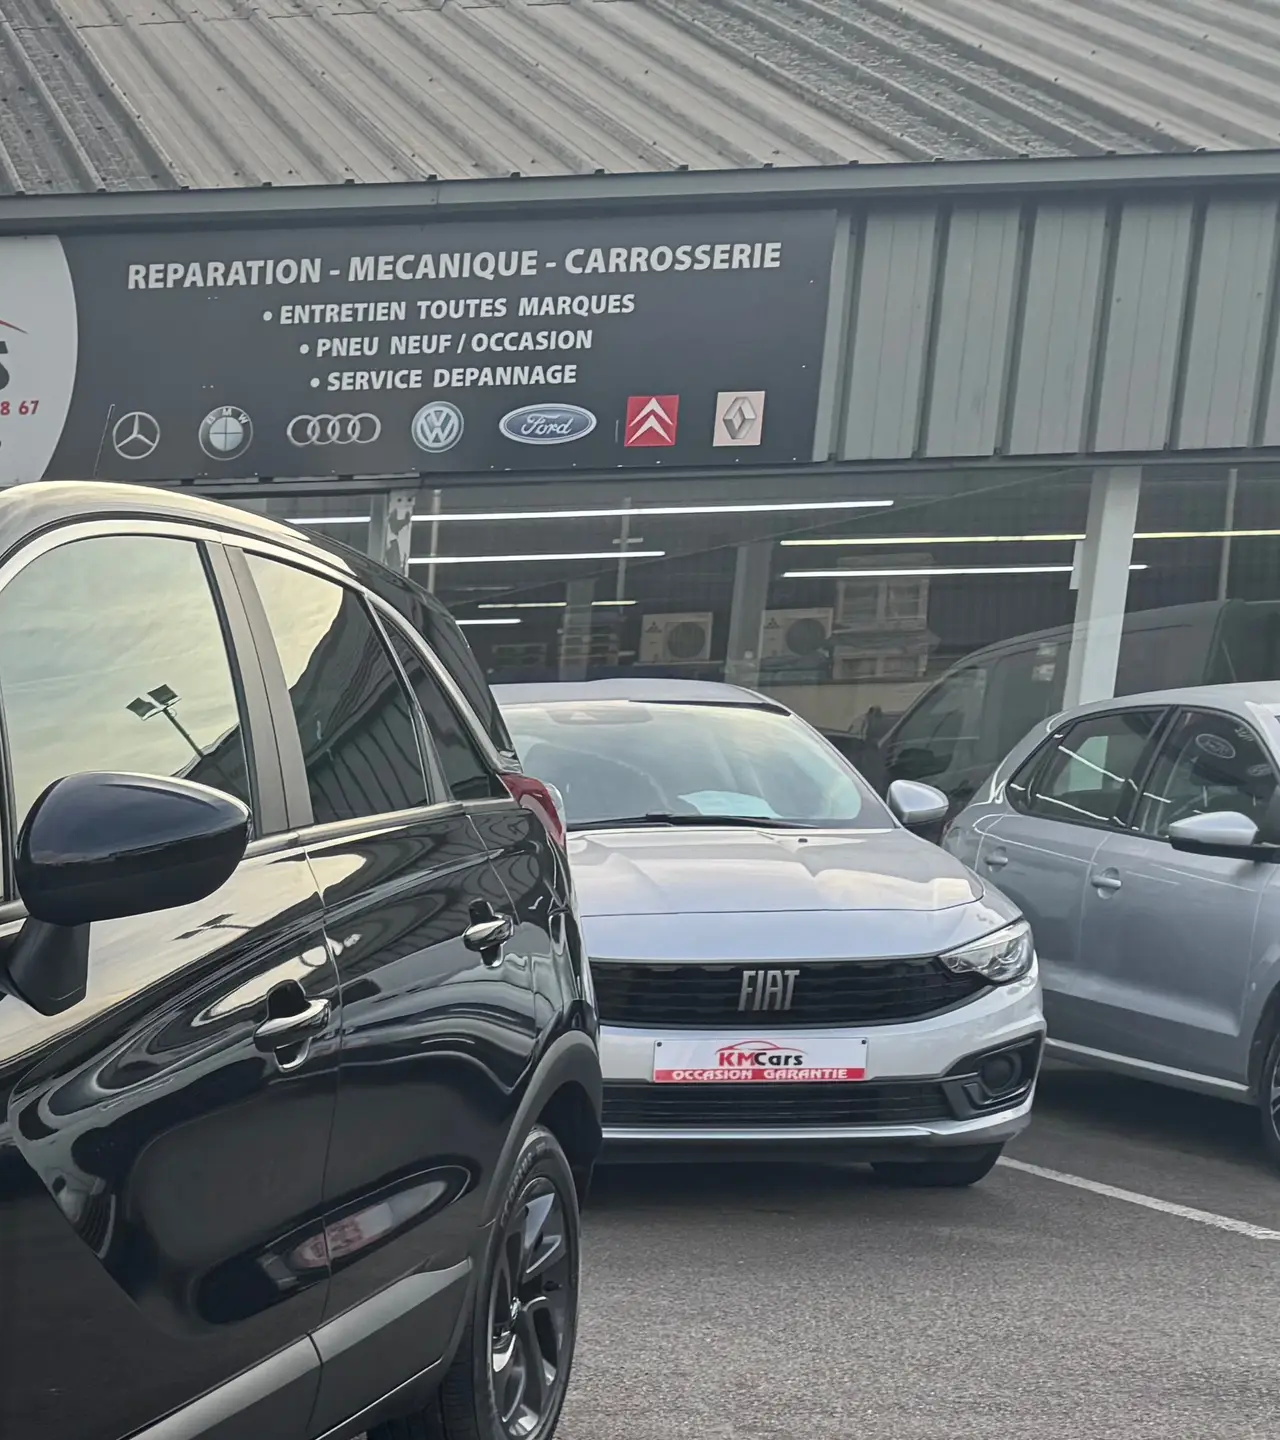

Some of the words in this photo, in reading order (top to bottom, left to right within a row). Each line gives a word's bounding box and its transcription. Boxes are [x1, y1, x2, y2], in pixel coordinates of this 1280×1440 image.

[128, 258, 322, 289] REPARATION
[348, 250, 538, 282] MECANIQUE
[565, 242, 782, 274] CARROSSERIE
[280, 301, 406, 325] ENTRETIEN
[417, 297, 507, 320] TOUTES
[518, 293, 636, 317] MARQUES
[316, 336, 379, 357] PNEU
[390, 333, 452, 355] NEUF
[471, 329, 593, 352] OCCASION
[327, 369, 423, 391] SERVICE
[433, 364, 578, 388] DEPANNAGE
[18, 399, 40, 415] 67
[521, 413, 574, 436] Ford
[737, 969, 800, 1012] FIAT
[672, 1069, 753, 1081] OCCASION
[763, 1068, 848, 1080] GARANTIE
